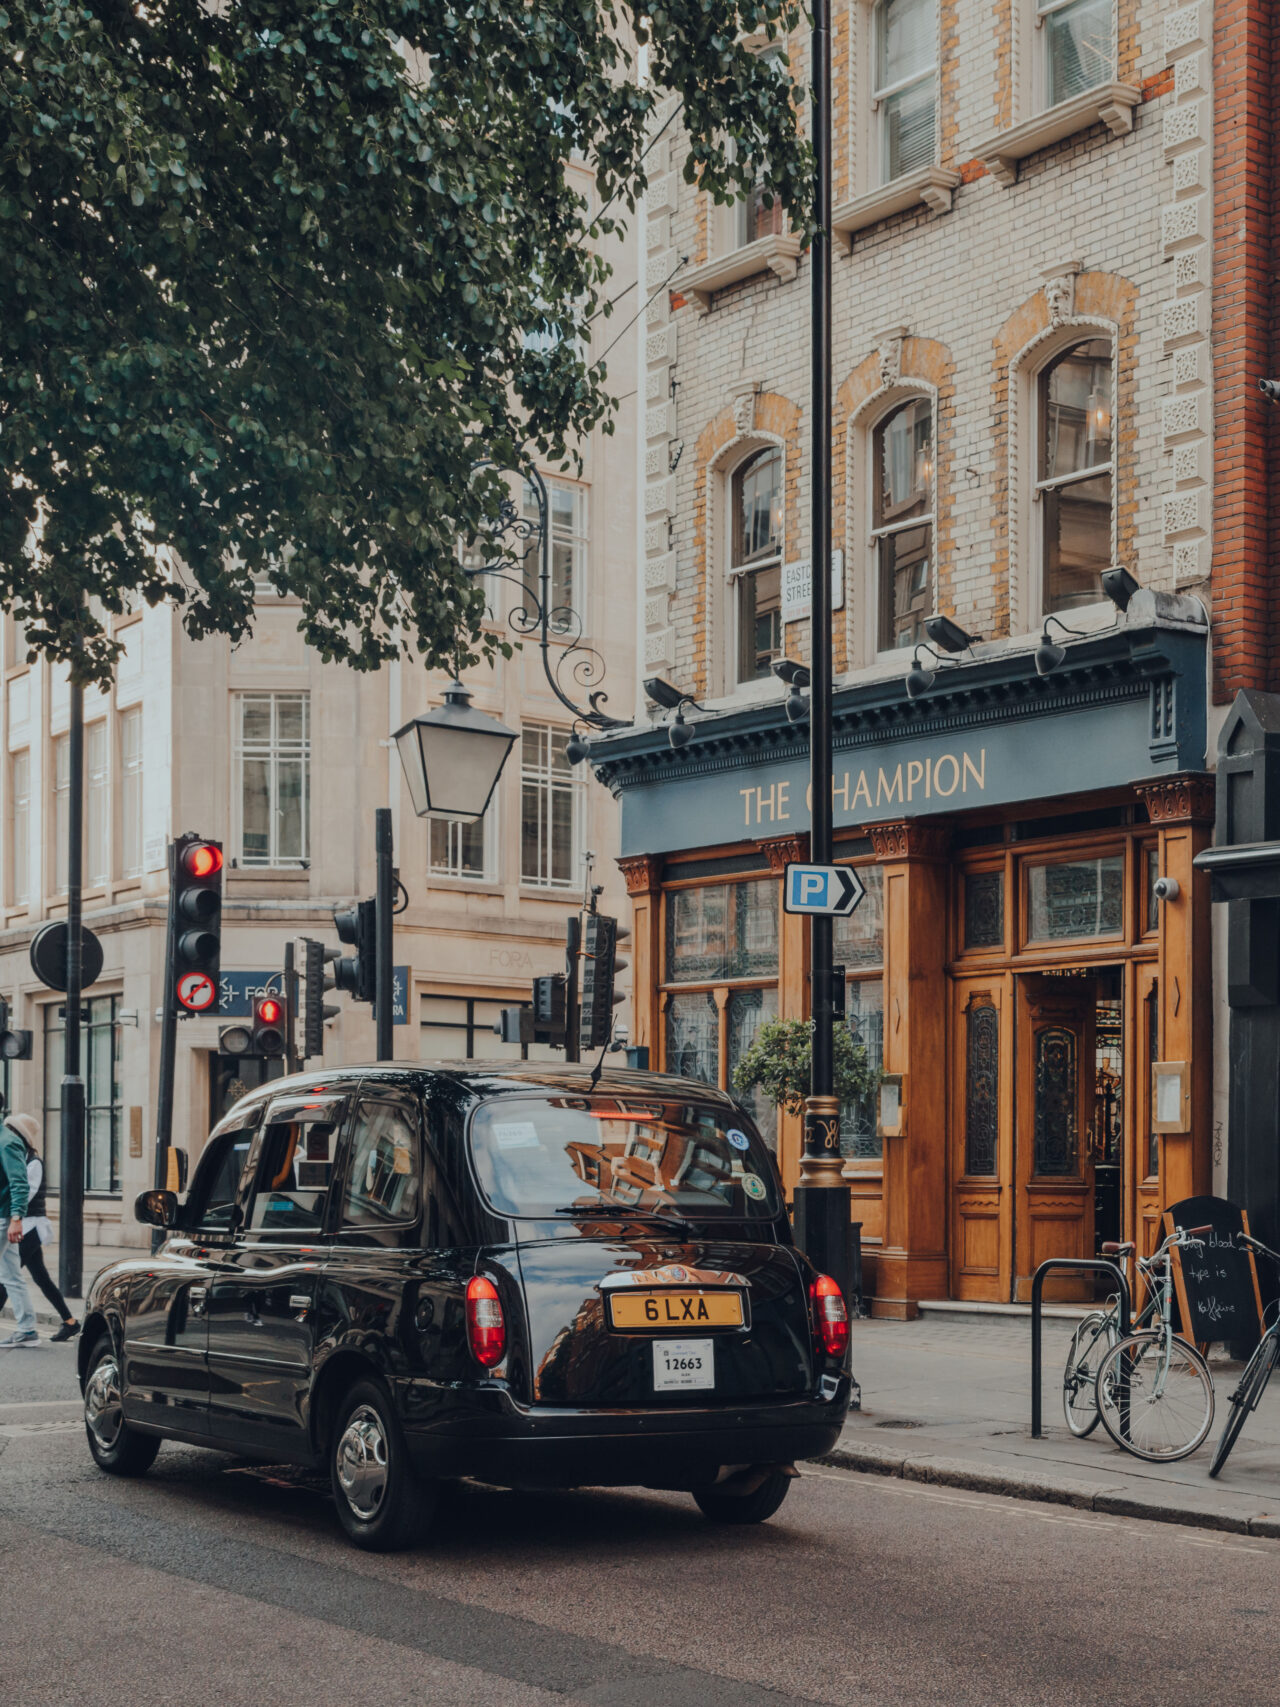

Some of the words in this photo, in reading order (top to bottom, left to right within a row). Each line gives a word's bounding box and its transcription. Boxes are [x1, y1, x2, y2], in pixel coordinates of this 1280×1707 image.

[786, 582, 811, 602] STREE
[739, 781, 790, 826] THE
[806, 749, 986, 815] HAMPION
[800, 874, 824, 904] P
[488, 948, 534, 969] FORA
[244, 986, 287, 1000] FOR
[1208, 1231, 1236, 1249] blood
[1188, 1263, 1209, 1284] type
[1215, 1264, 1227, 1278] is
[645, 1299, 659, 1321] 6
[664, 1298, 710, 1321] LXA
[665, 1357, 702, 1371] 12663
